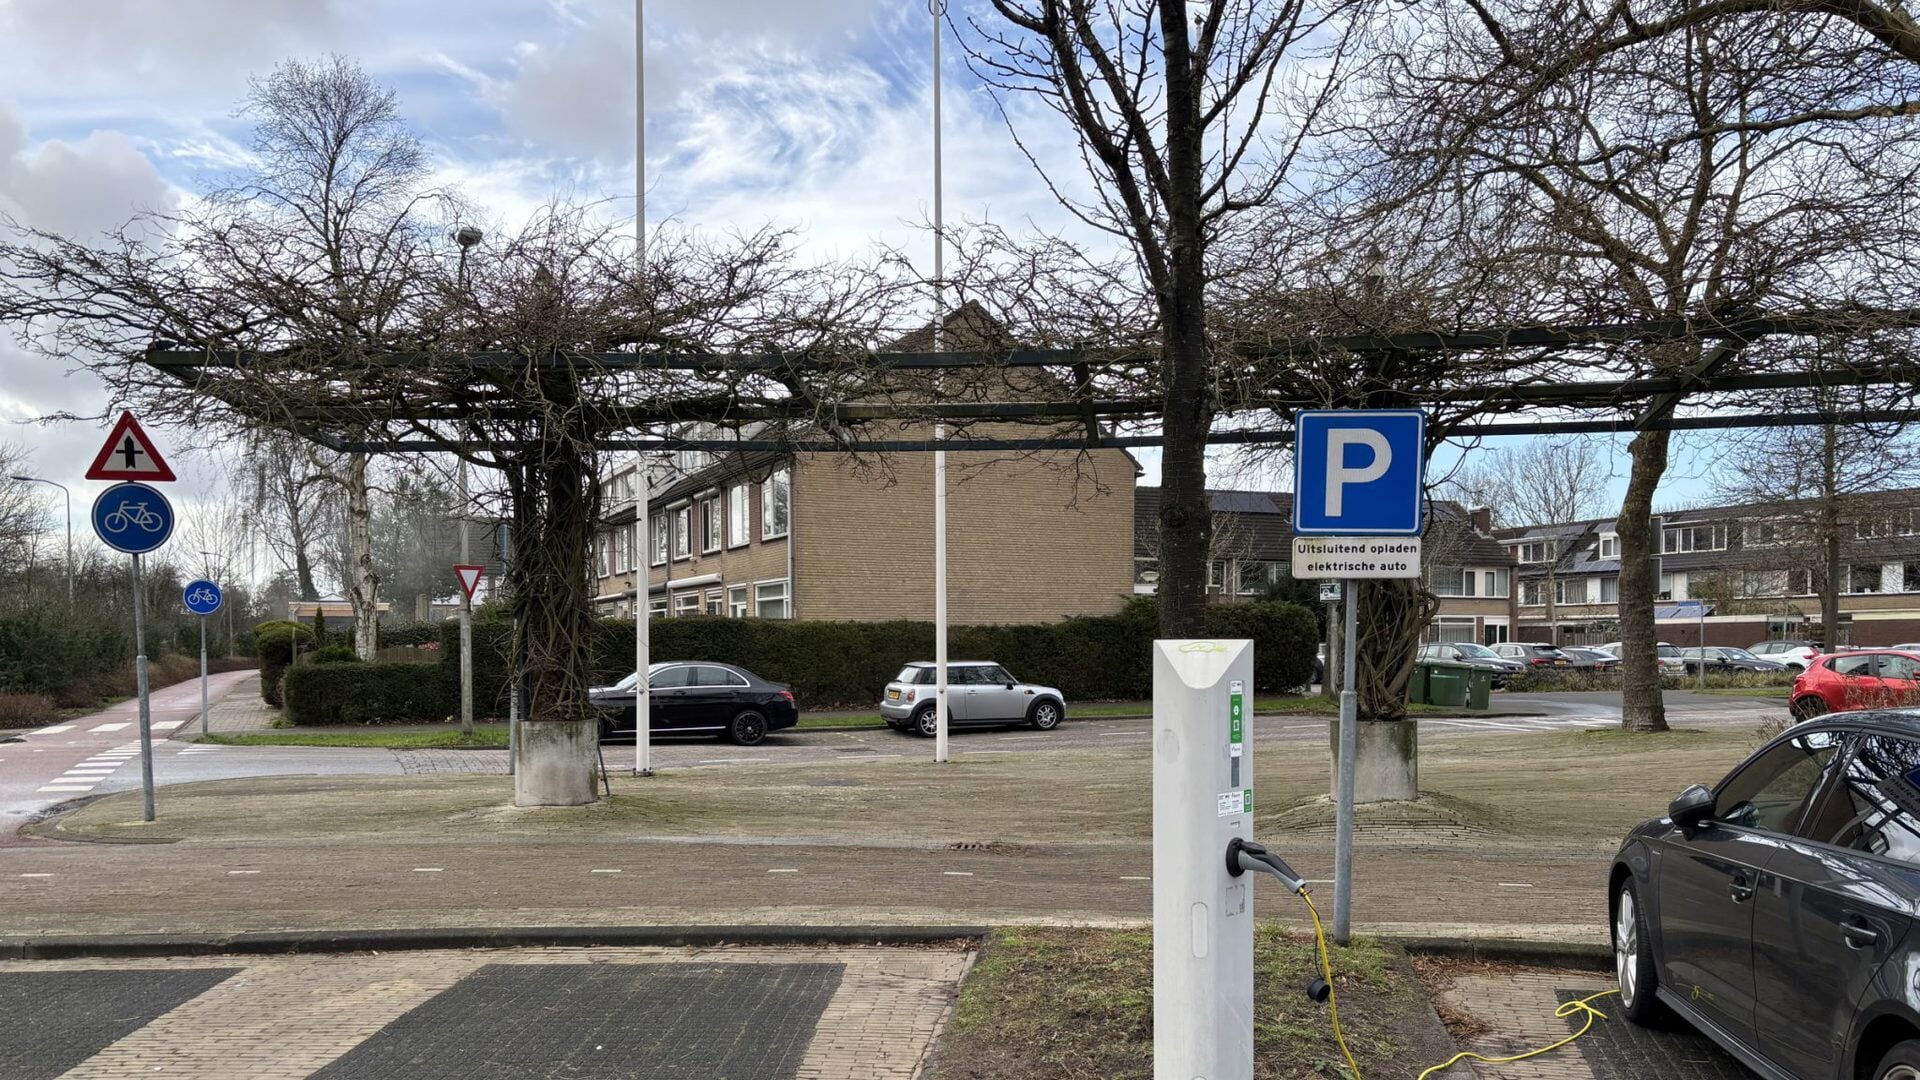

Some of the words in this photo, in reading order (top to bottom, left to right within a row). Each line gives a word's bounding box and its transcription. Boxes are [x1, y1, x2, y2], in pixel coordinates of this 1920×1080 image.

[1324, 428, 1393, 517] P
[1298, 543, 1366, 554] Uitsluitend
[1370, 543, 1417, 555] opladen
[1307, 561, 1376, 571] elektrische
[1380, 562, 1407, 571] auto
